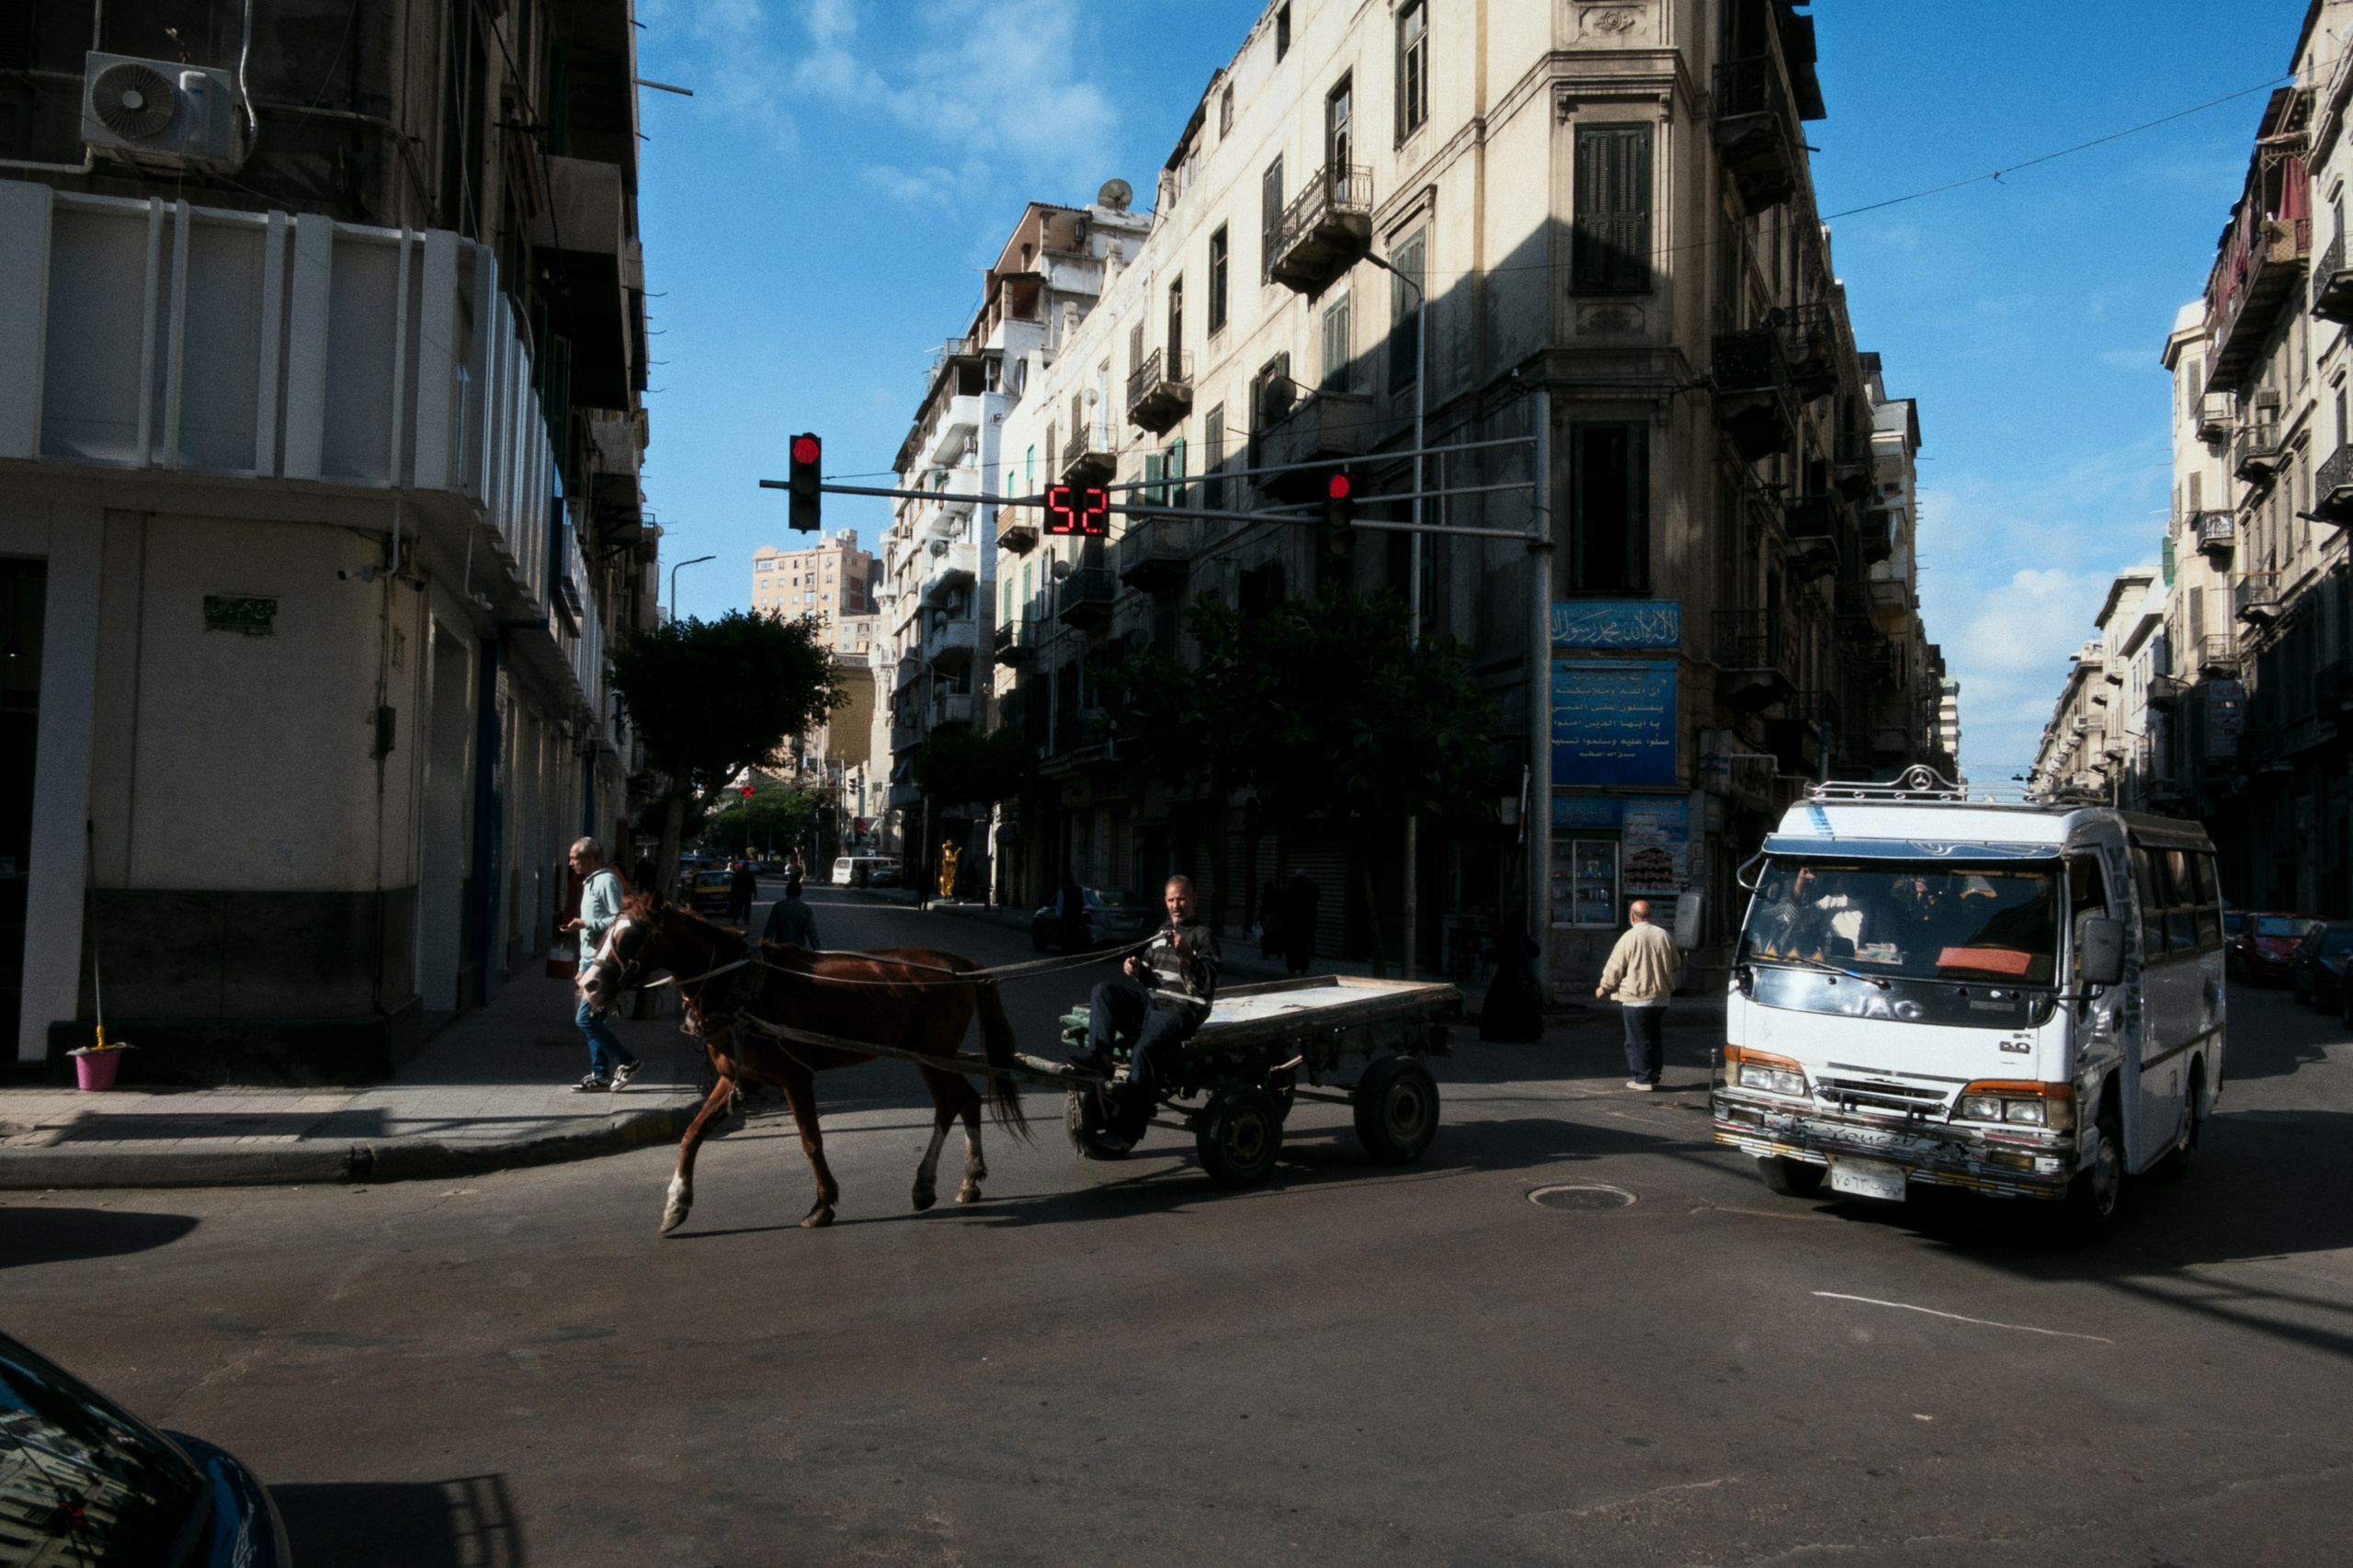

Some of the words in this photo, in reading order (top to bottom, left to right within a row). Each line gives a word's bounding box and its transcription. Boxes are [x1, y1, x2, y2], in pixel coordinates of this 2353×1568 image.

[1049, 486, 1108, 533] 52
[1591, 621, 1621, 643] محمد
[1591, 704, 1615, 712] على
[1649, 720, 1661, 730] يا
[1620, 738, 1643, 747] عليه
[1842, 994, 1924, 1020] JAC
